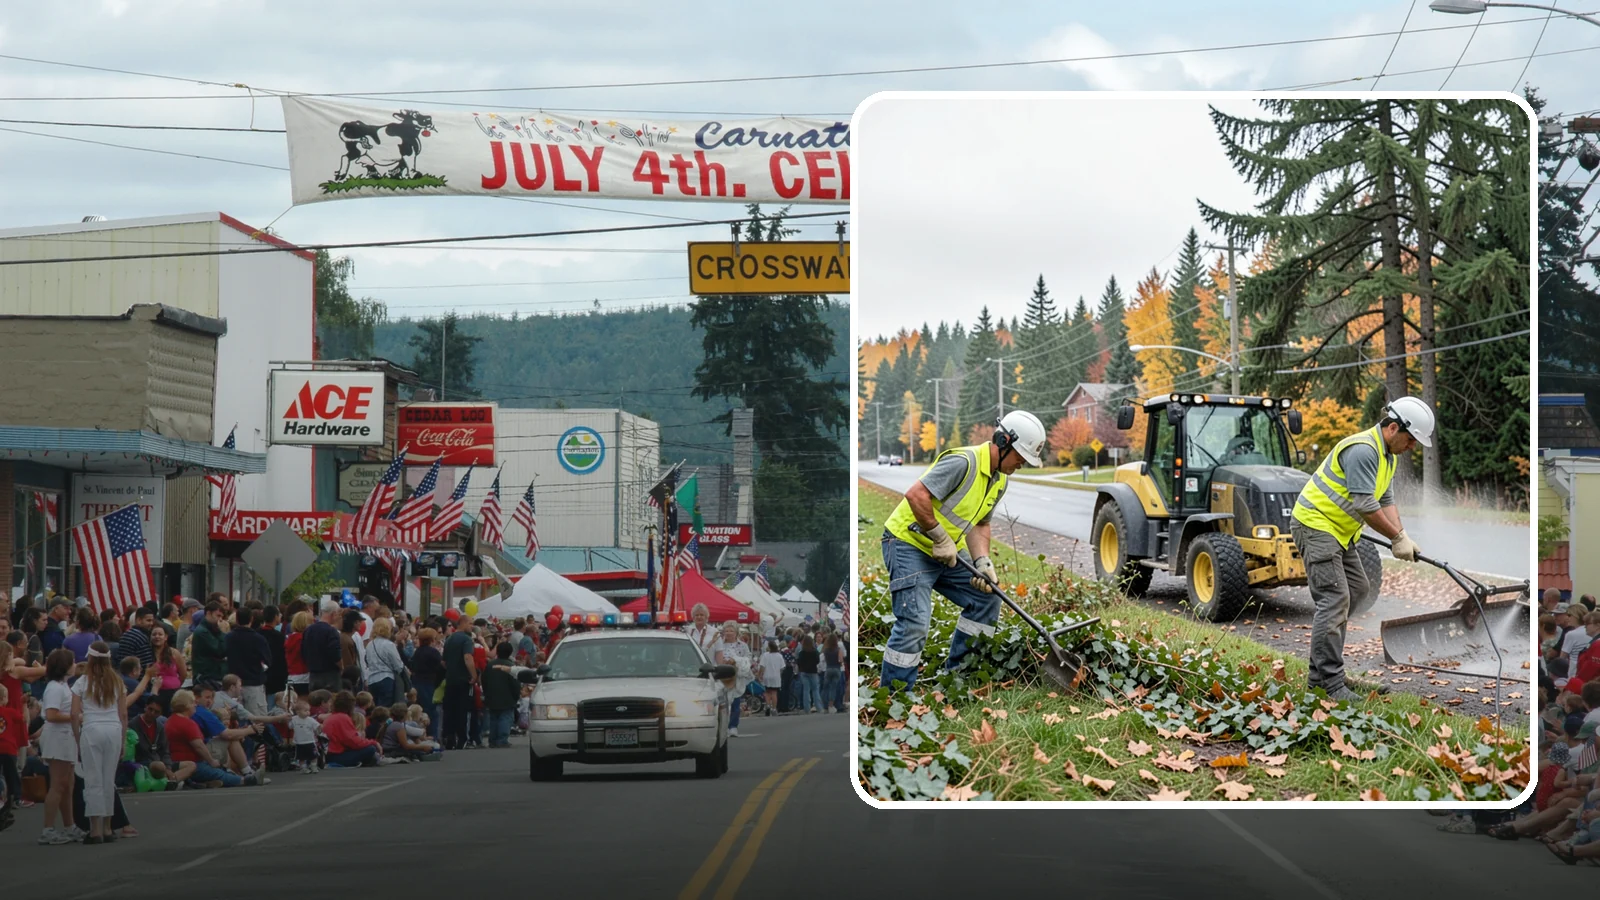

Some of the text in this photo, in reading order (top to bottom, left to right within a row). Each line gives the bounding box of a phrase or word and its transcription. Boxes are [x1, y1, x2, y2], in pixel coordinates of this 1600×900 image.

[481, 141, 605, 193] JULY
[632, 149, 746, 198] 4th.
[697, 254, 850, 280] CROSSWA
[282, 379, 374, 420] ACE
[406, 409, 453, 421] CEDAR
[283, 421, 371, 437] Hardware
[416, 428, 477, 447] Coca-Cola
[96, 485, 124, 494] Vincent
[126, 485, 136, 495] de
[138, 486, 155, 495] Paul
[688, 526, 741, 535] CRNATION
[700, 535, 730, 543] GLASS
